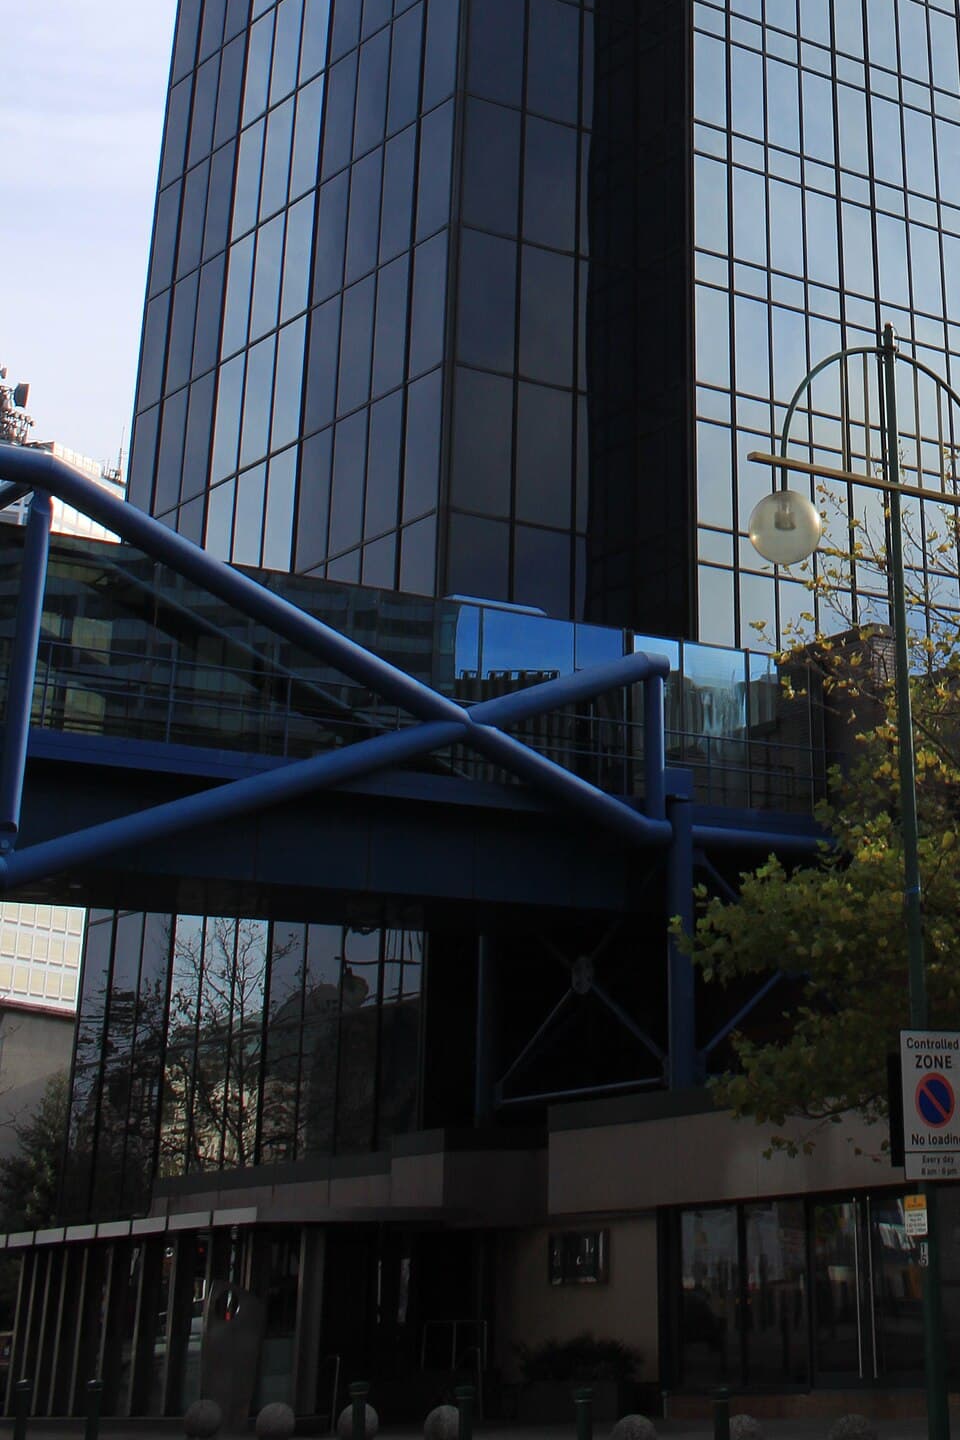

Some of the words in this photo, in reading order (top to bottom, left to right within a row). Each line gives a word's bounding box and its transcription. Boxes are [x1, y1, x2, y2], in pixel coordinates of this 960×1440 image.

[907, 1037, 960, 1050] Controlled
[915, 1054, 953, 1069] ZONE
[911, 1133, 925, 1145] No
[922, 1155, 941, 1166] Every
[943, 1155, 955, 1166] day
